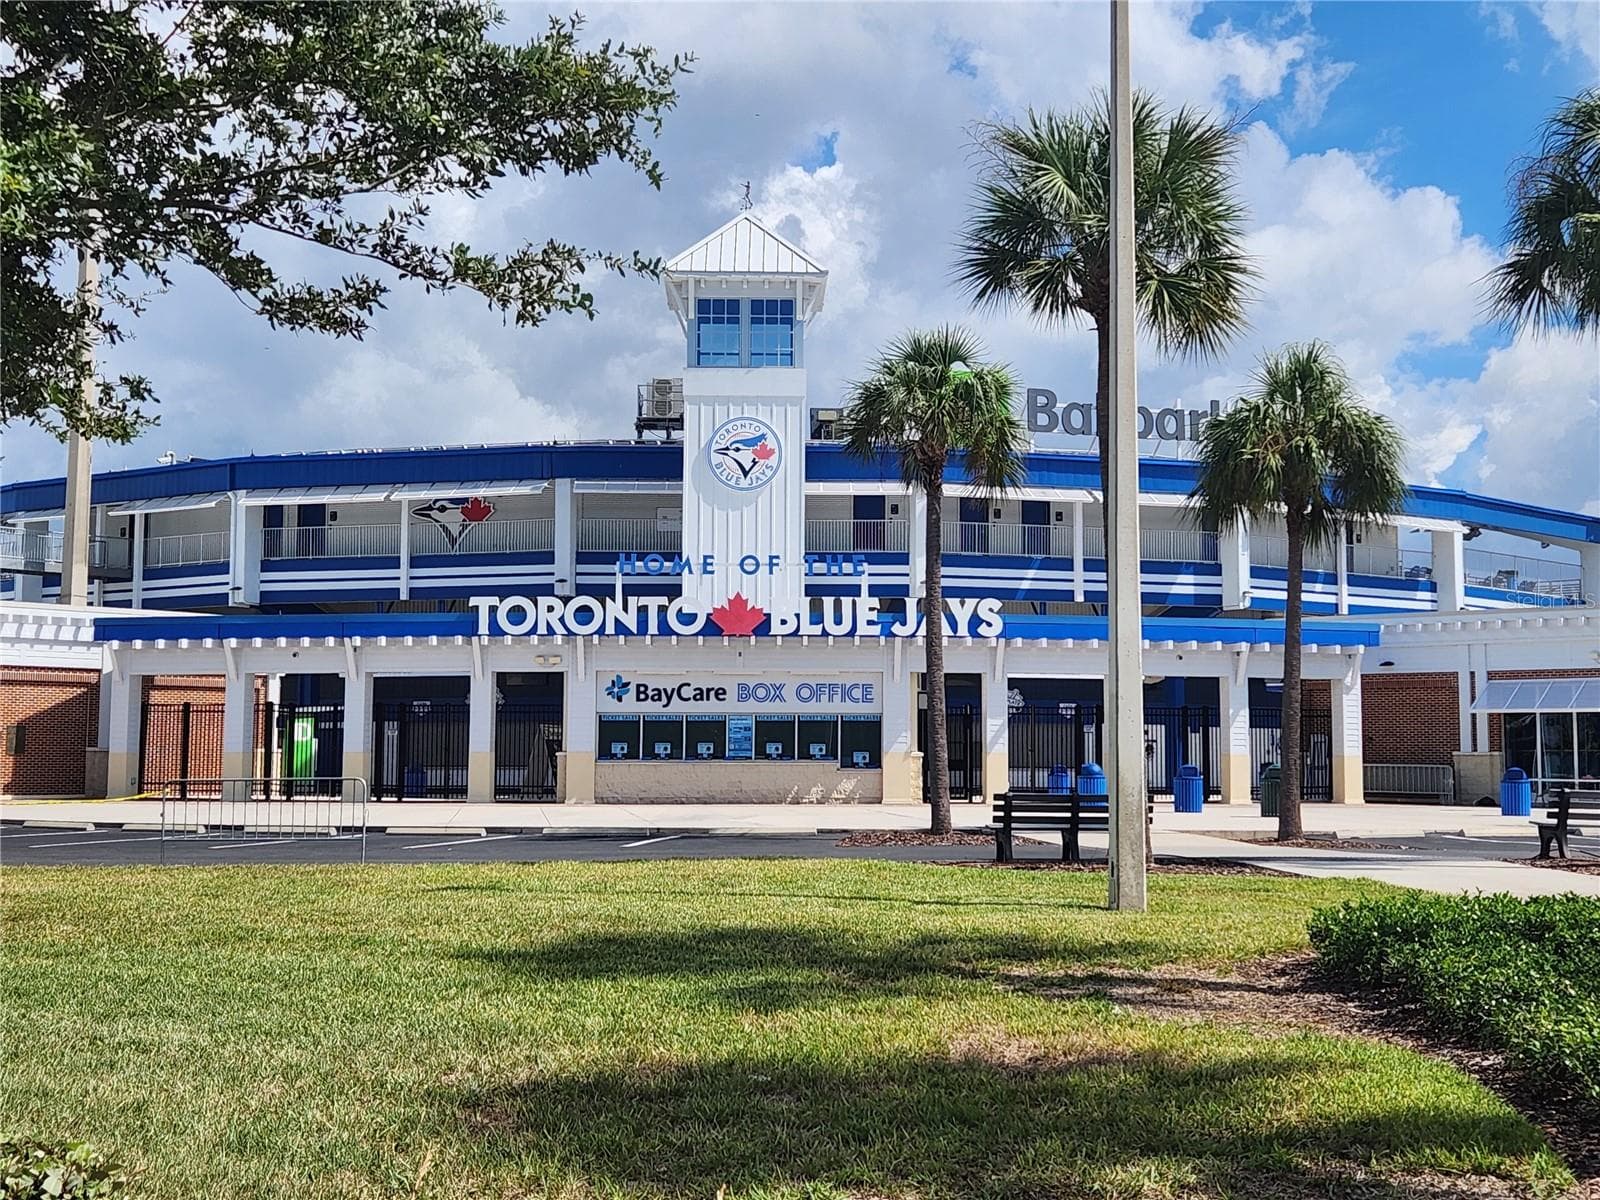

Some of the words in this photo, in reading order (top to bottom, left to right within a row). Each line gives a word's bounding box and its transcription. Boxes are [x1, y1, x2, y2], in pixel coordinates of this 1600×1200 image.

[1027, 388, 1220, 442] Baar
[715, 422, 761, 446] TORONTO
[714, 461, 742, 485] BLUE
[748, 463, 774, 486] JAYS
[618, 553, 715, 576] HOME
[739, 554, 781, 576] OF
[804, 554, 865, 577] THE
[469, 596, 708, 636] TORONTO
[769, 596, 882, 636] BLUE
[635, 683, 727, 707] BayCare
[736, 682, 787, 703] BOX
[795, 682, 875, 704] OFFICE
